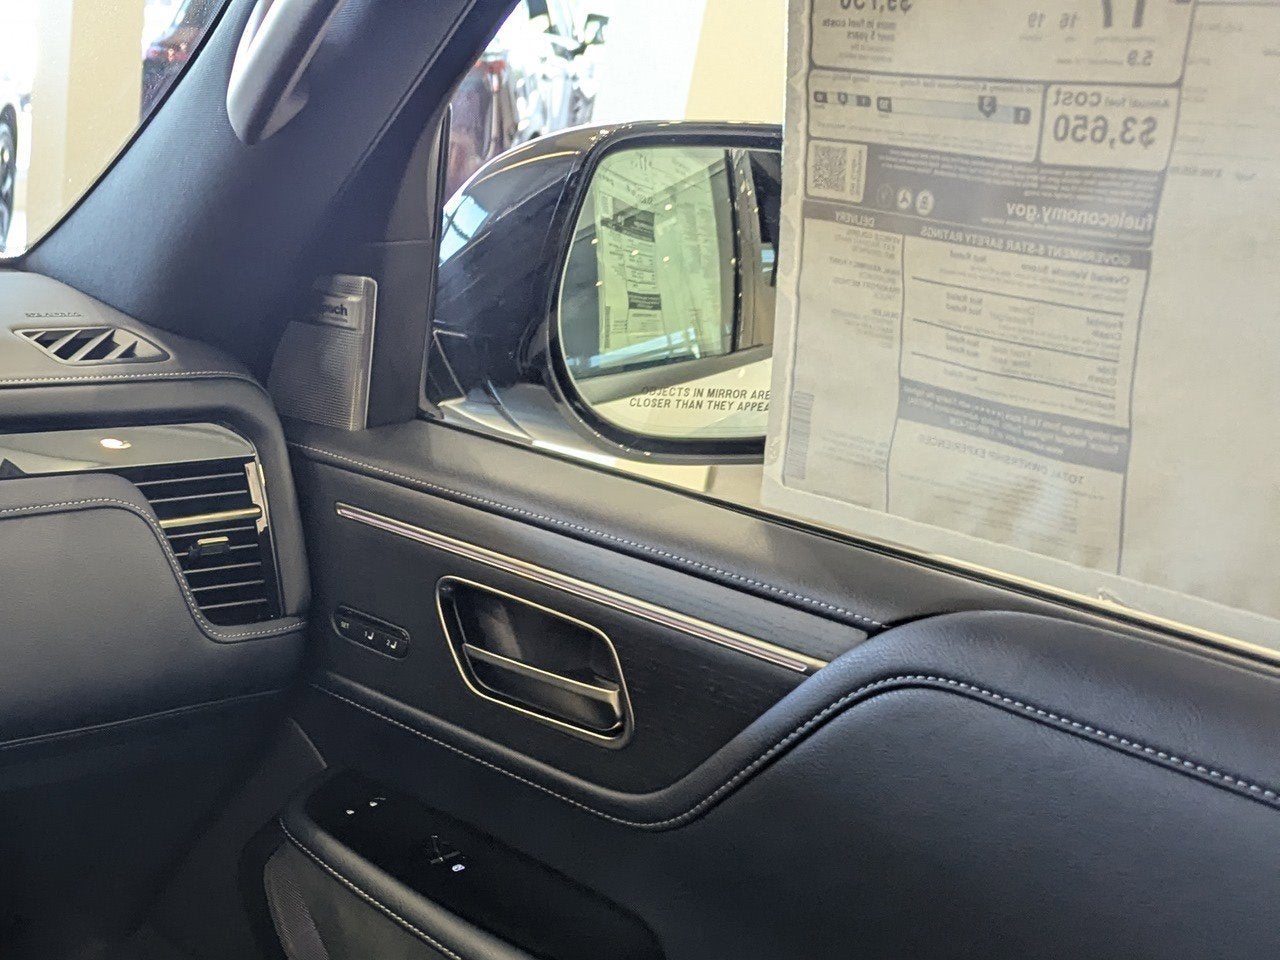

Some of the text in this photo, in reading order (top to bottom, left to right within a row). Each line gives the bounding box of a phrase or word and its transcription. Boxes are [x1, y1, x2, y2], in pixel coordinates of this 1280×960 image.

[642, 386, 770, 400] OBJECTS IN MIRROR ARE
[629, 398, 770, 412] CLOSER THAN THEY APPEA
